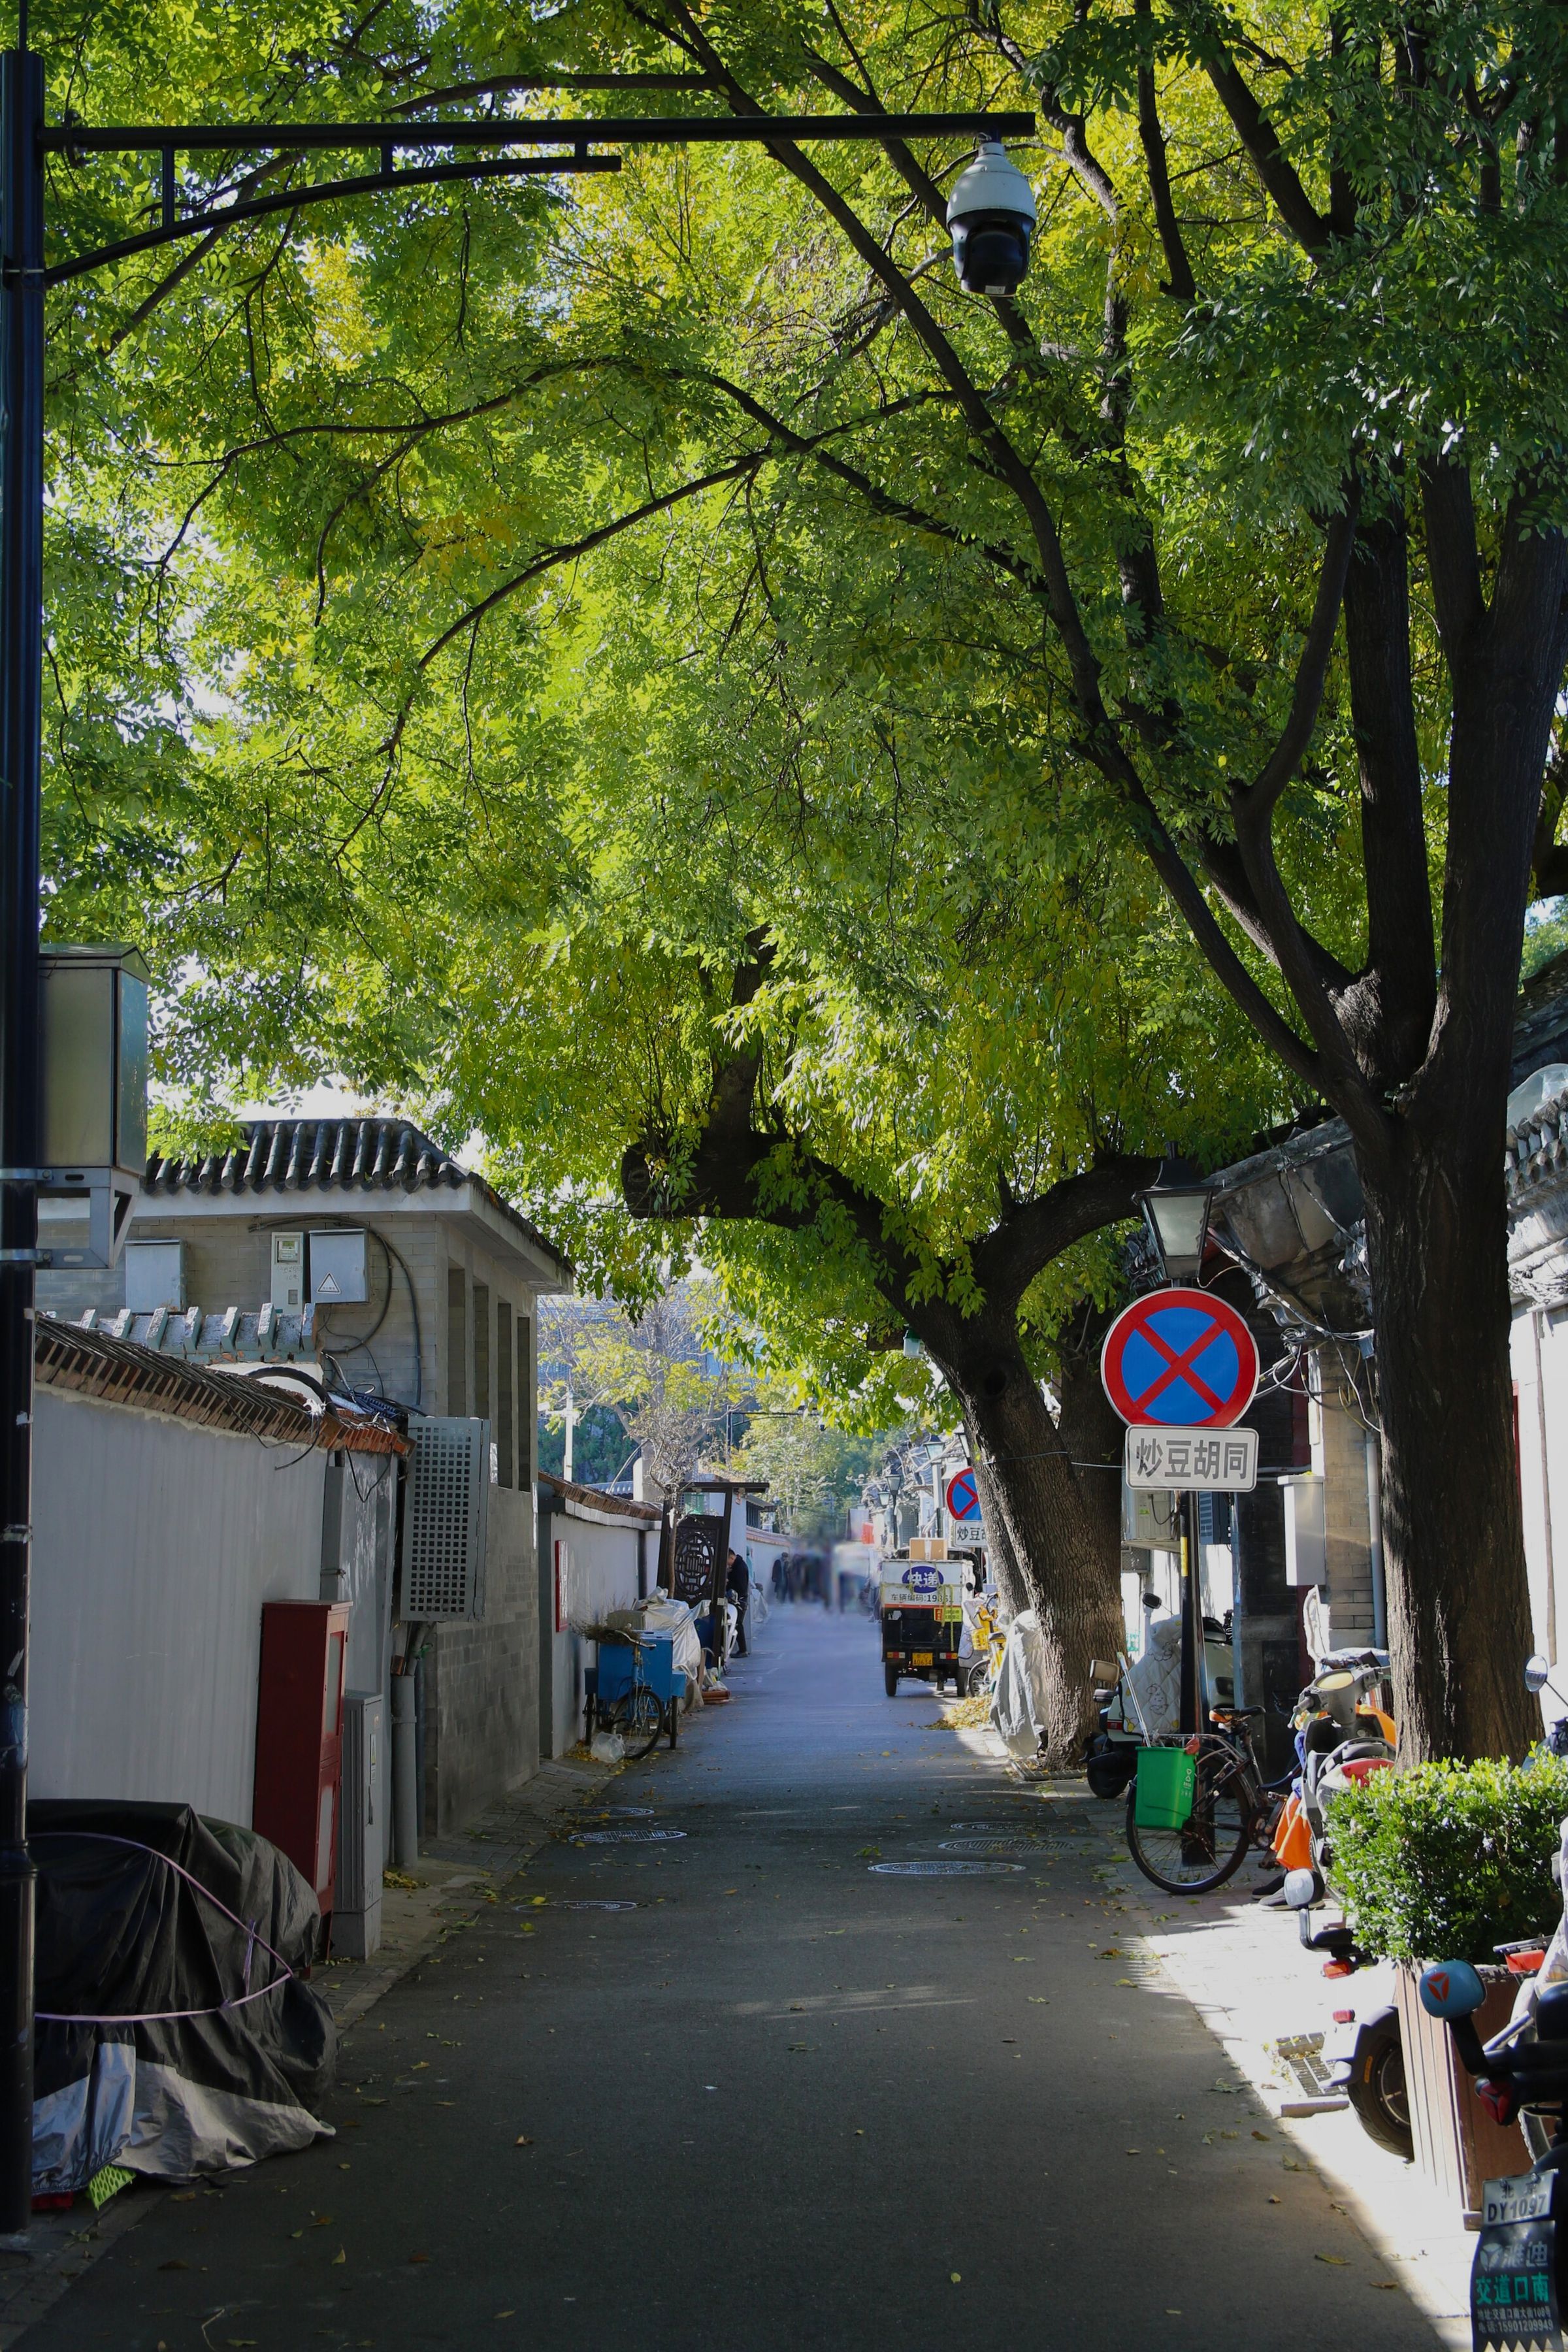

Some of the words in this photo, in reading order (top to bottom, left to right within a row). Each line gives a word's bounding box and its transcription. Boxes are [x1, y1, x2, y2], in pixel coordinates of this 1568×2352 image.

[1135, 1437, 1249, 1480] 炒豆胡同
[907, 1571, 939, 1588] 快递
[1488, 2193, 1546, 2222] DY1097
[1502, 2241, 1548, 2268] 雅迪
[1475, 2272, 1550, 2305] 交道口南
